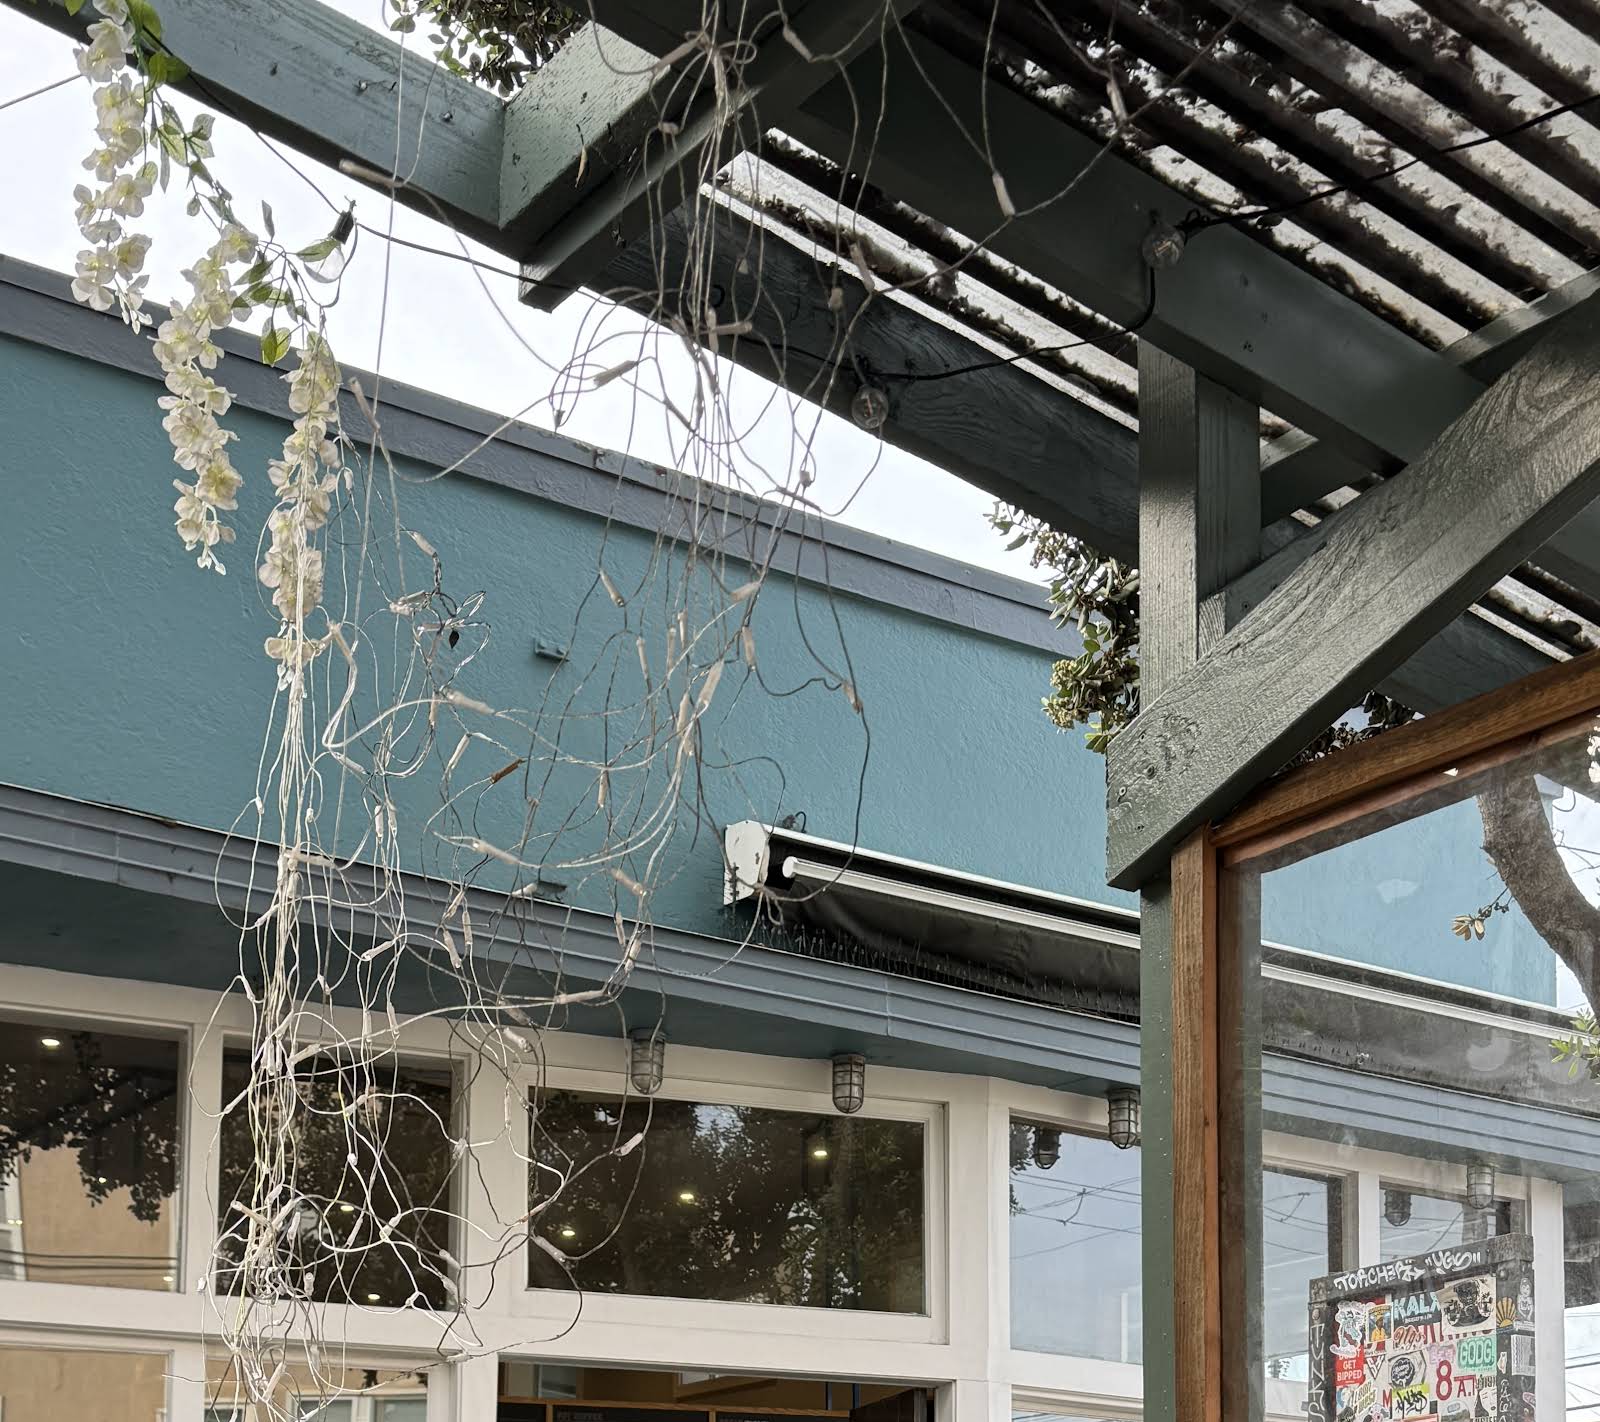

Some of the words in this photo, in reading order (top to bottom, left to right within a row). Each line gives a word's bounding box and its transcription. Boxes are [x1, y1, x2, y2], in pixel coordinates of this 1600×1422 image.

[1343, 1360, 1356, 1370] GET
[1337, 1369, 1362, 1381] BIPPED
[1436, 1360, 1452, 1401] 8
